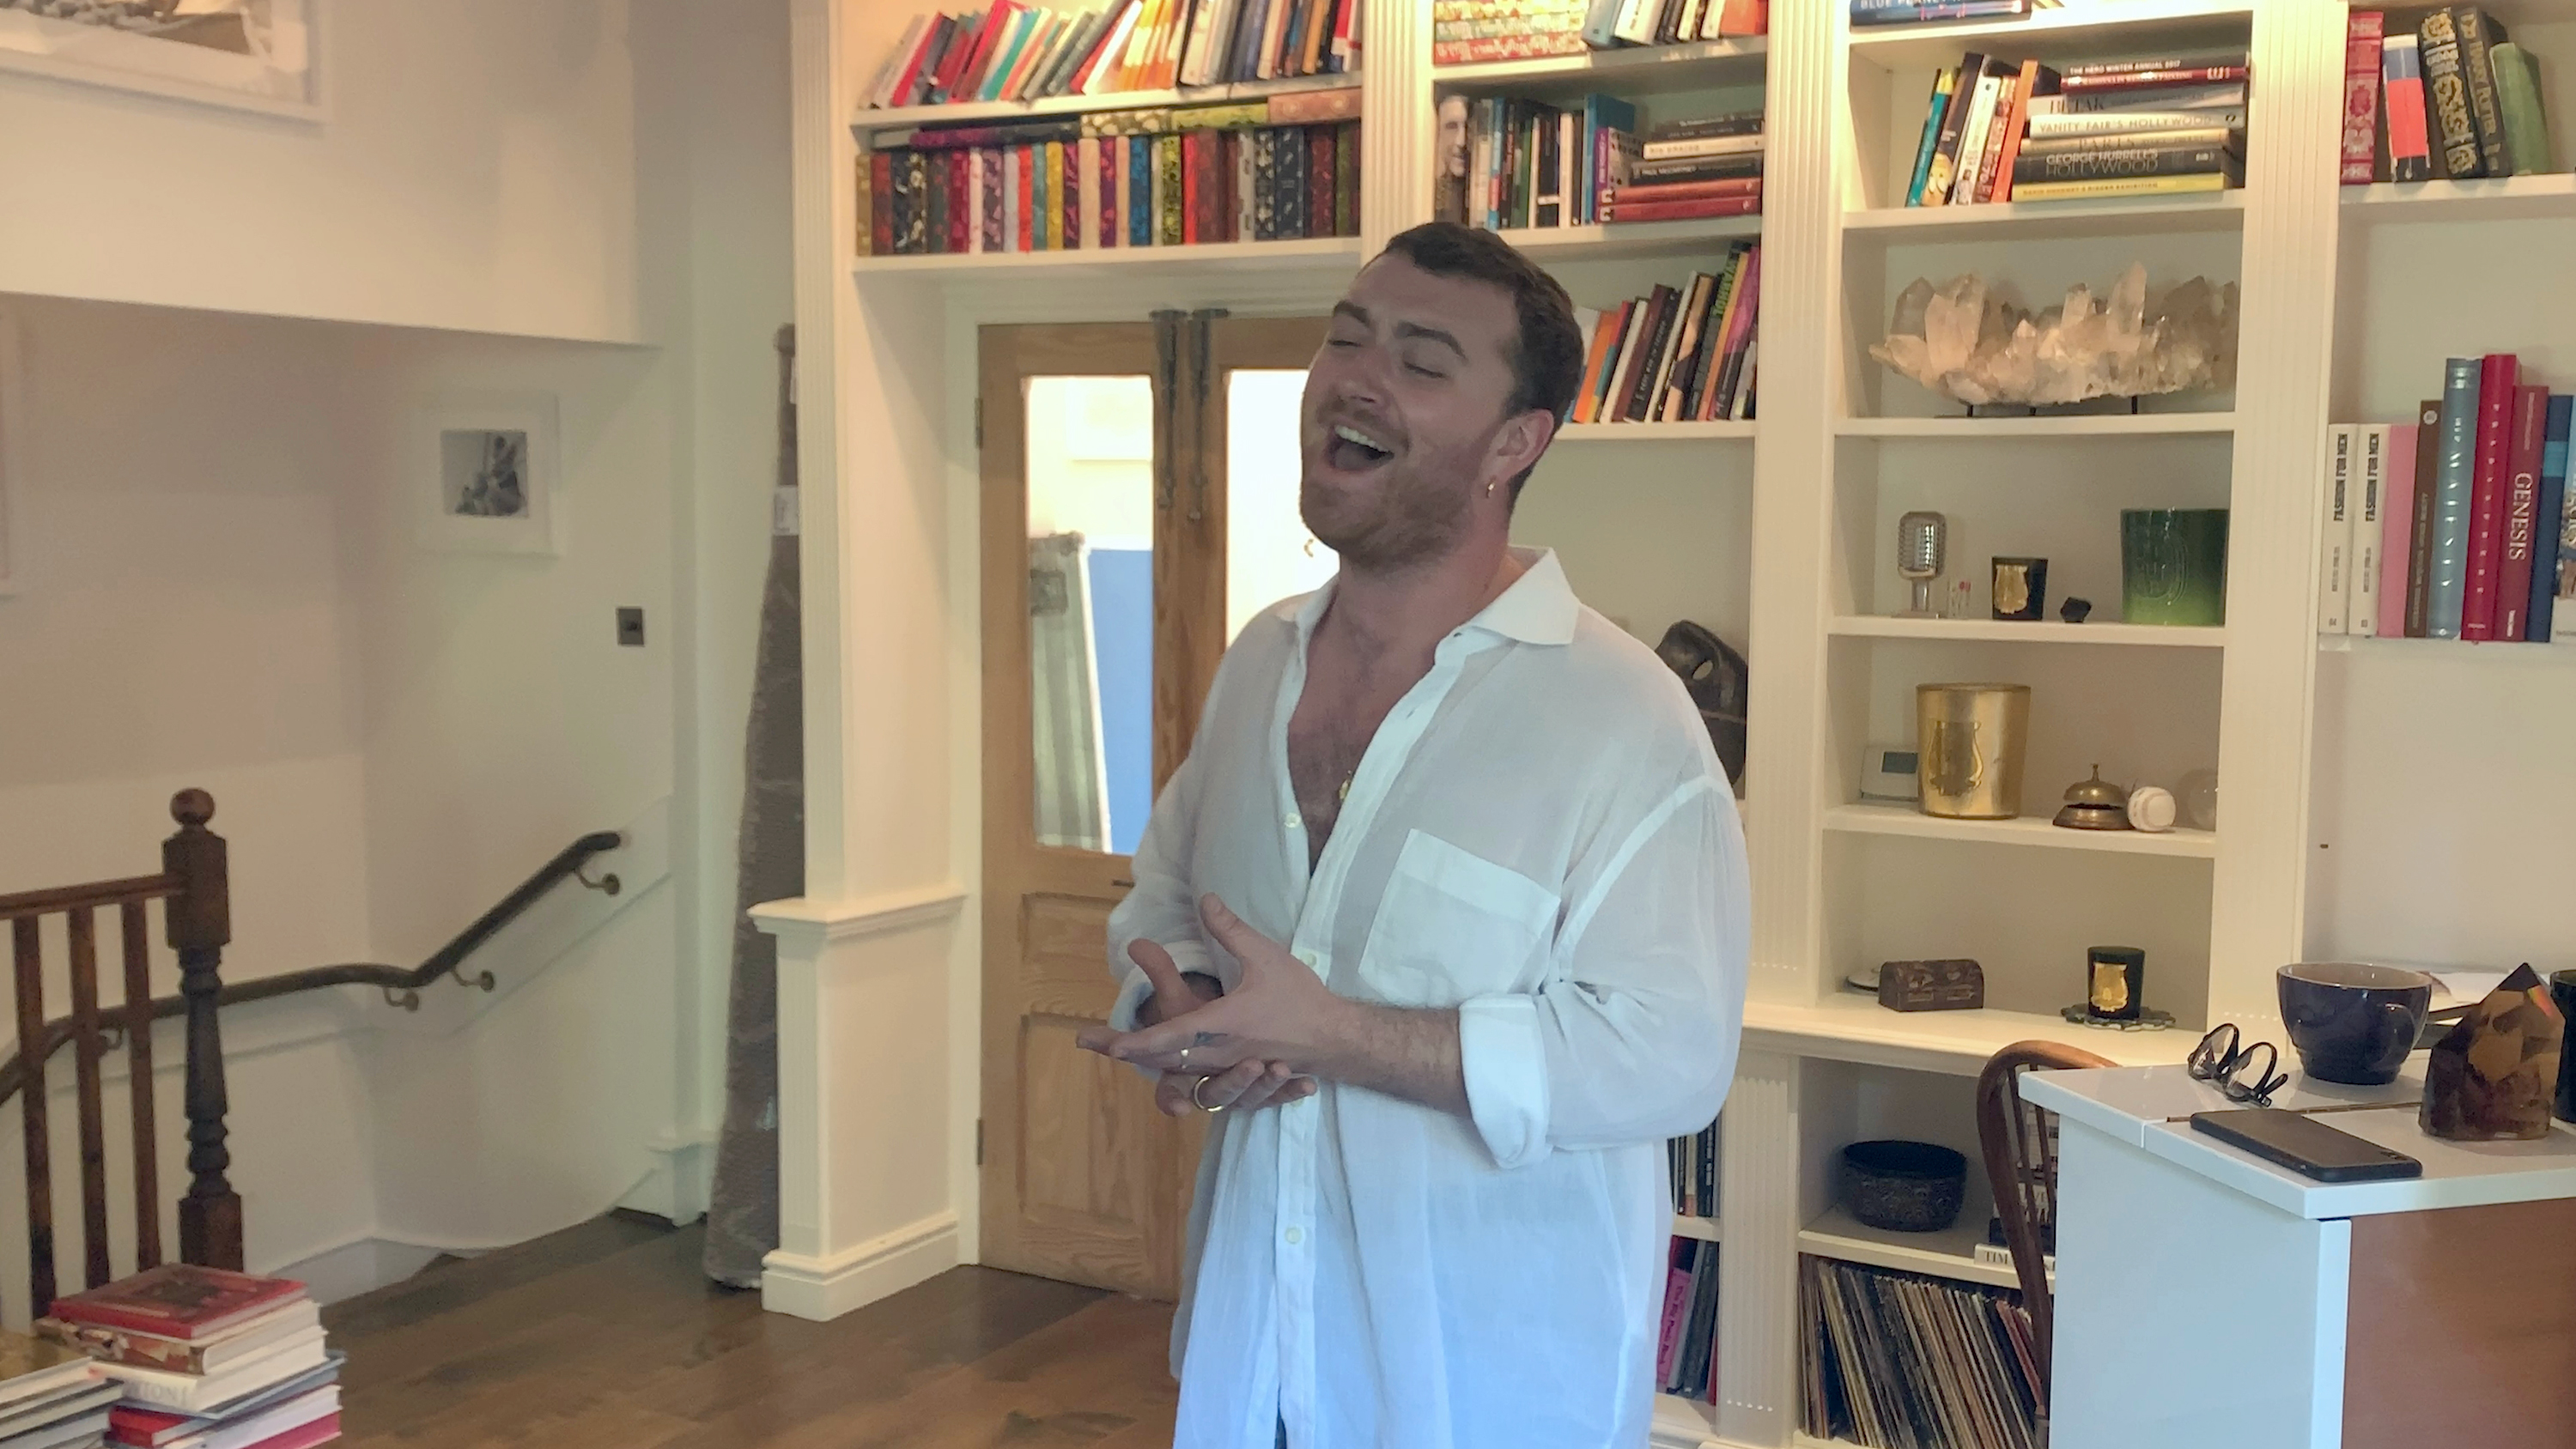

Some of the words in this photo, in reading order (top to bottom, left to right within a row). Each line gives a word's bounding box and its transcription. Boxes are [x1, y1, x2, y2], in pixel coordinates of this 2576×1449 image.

[2105, 64, 2133, 73] WINTER
[2135, 61, 2163, 70] ANNUAL
[2039, 122, 2079, 133] VANITY
[2086, 119, 2123, 130] FAIR'S
[2129, 115, 2212, 129] HOLLYWOOD
[2046, 152, 2097, 166] GEORGE
[2046, 160, 2158, 178] HOLLYWOOD
[2508, 472, 2532, 561] GENESIS
